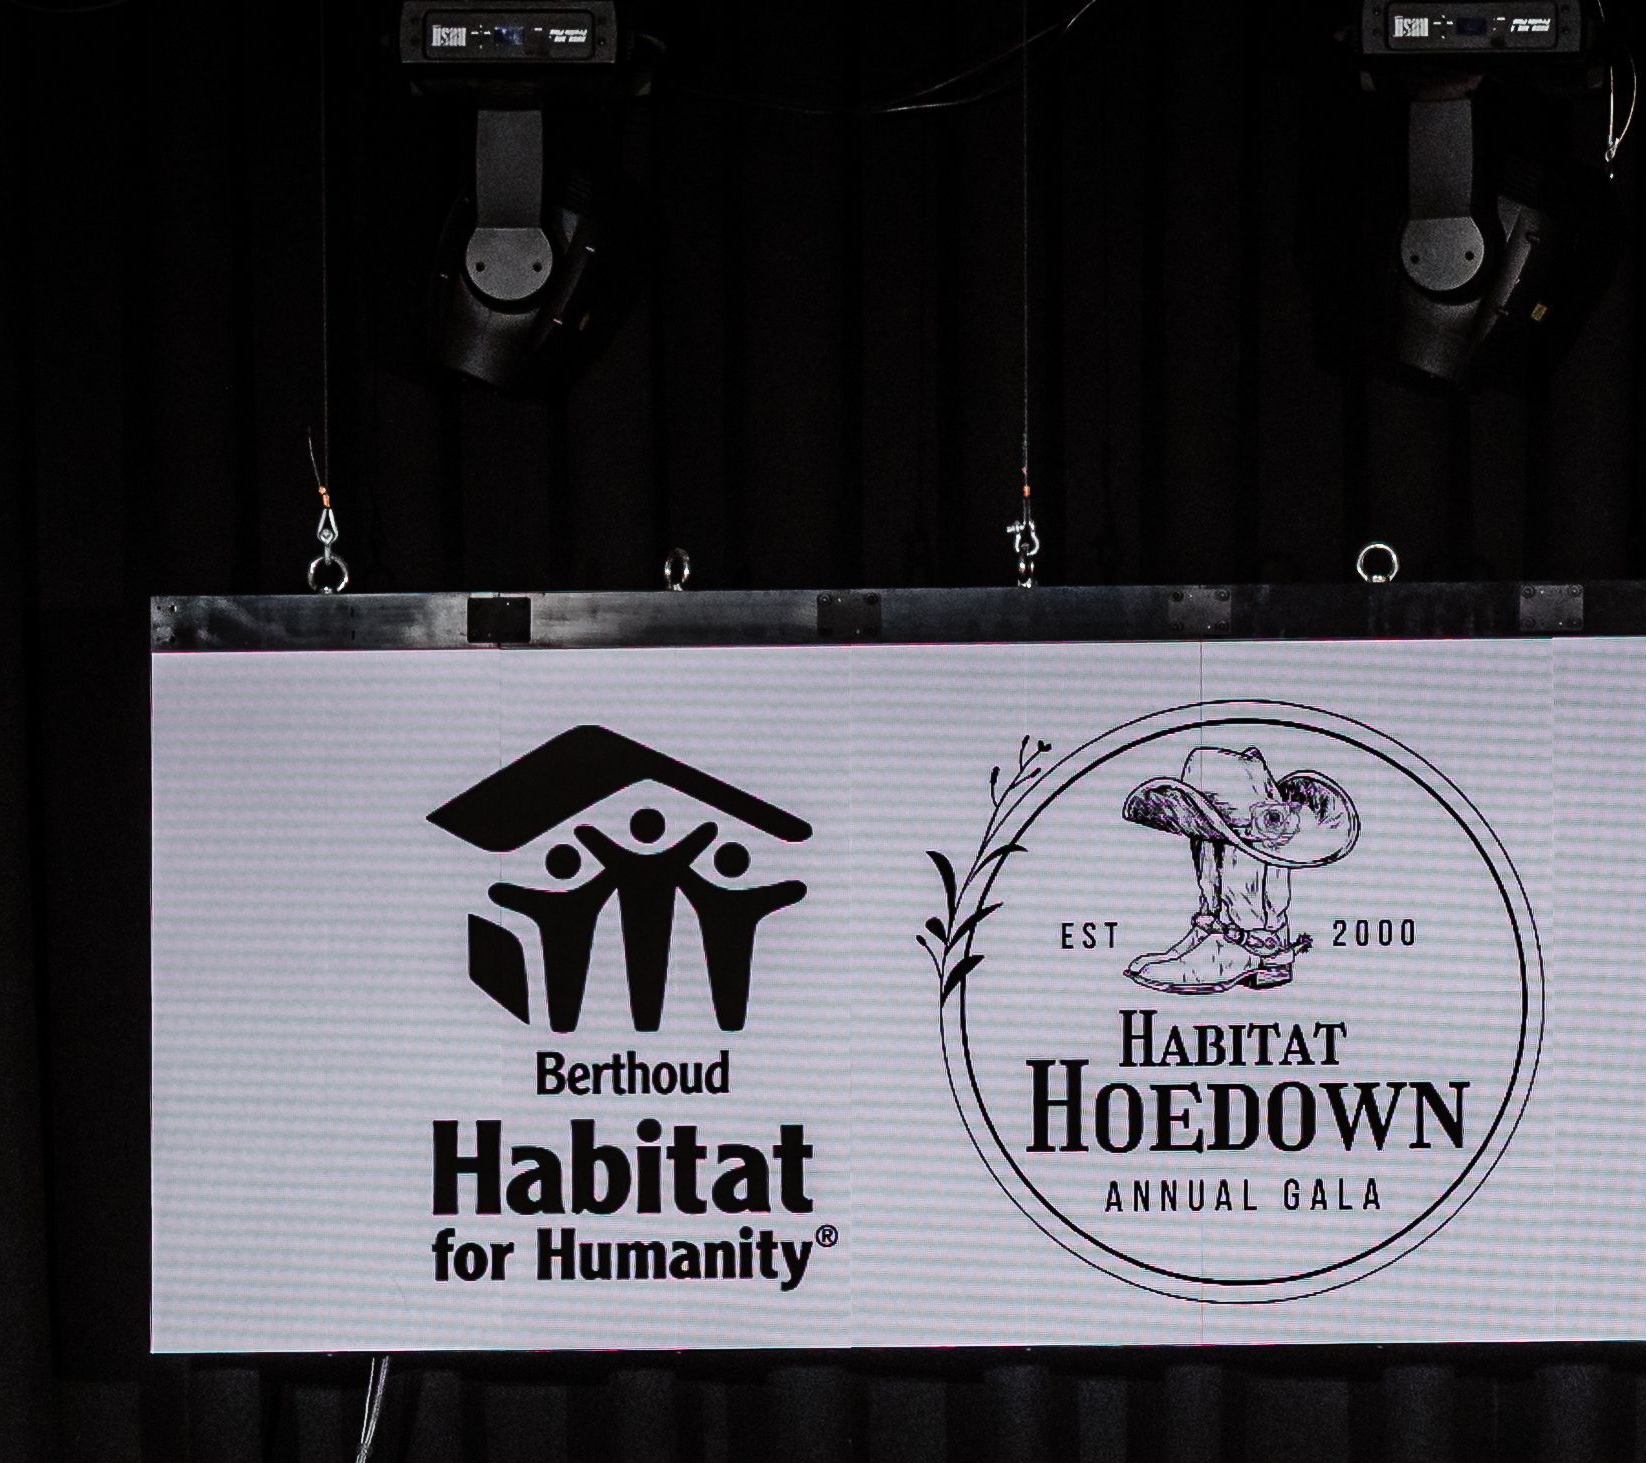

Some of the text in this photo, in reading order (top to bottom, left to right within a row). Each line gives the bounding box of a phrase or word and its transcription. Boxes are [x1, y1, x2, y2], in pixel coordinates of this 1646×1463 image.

[1061, 918, 1416, 950] EST 2000
[1118, 1009, 1348, 1068] HABITAT
[536, 1051, 730, 1096] Berthoud
[1025, 1057, 1472, 1154] HOEDOWN
[432, 1118, 814, 1216] Habitat
[1104, 1177, 1382, 1213] ANNUAL GALA
[431, 1227, 516, 1282] for
